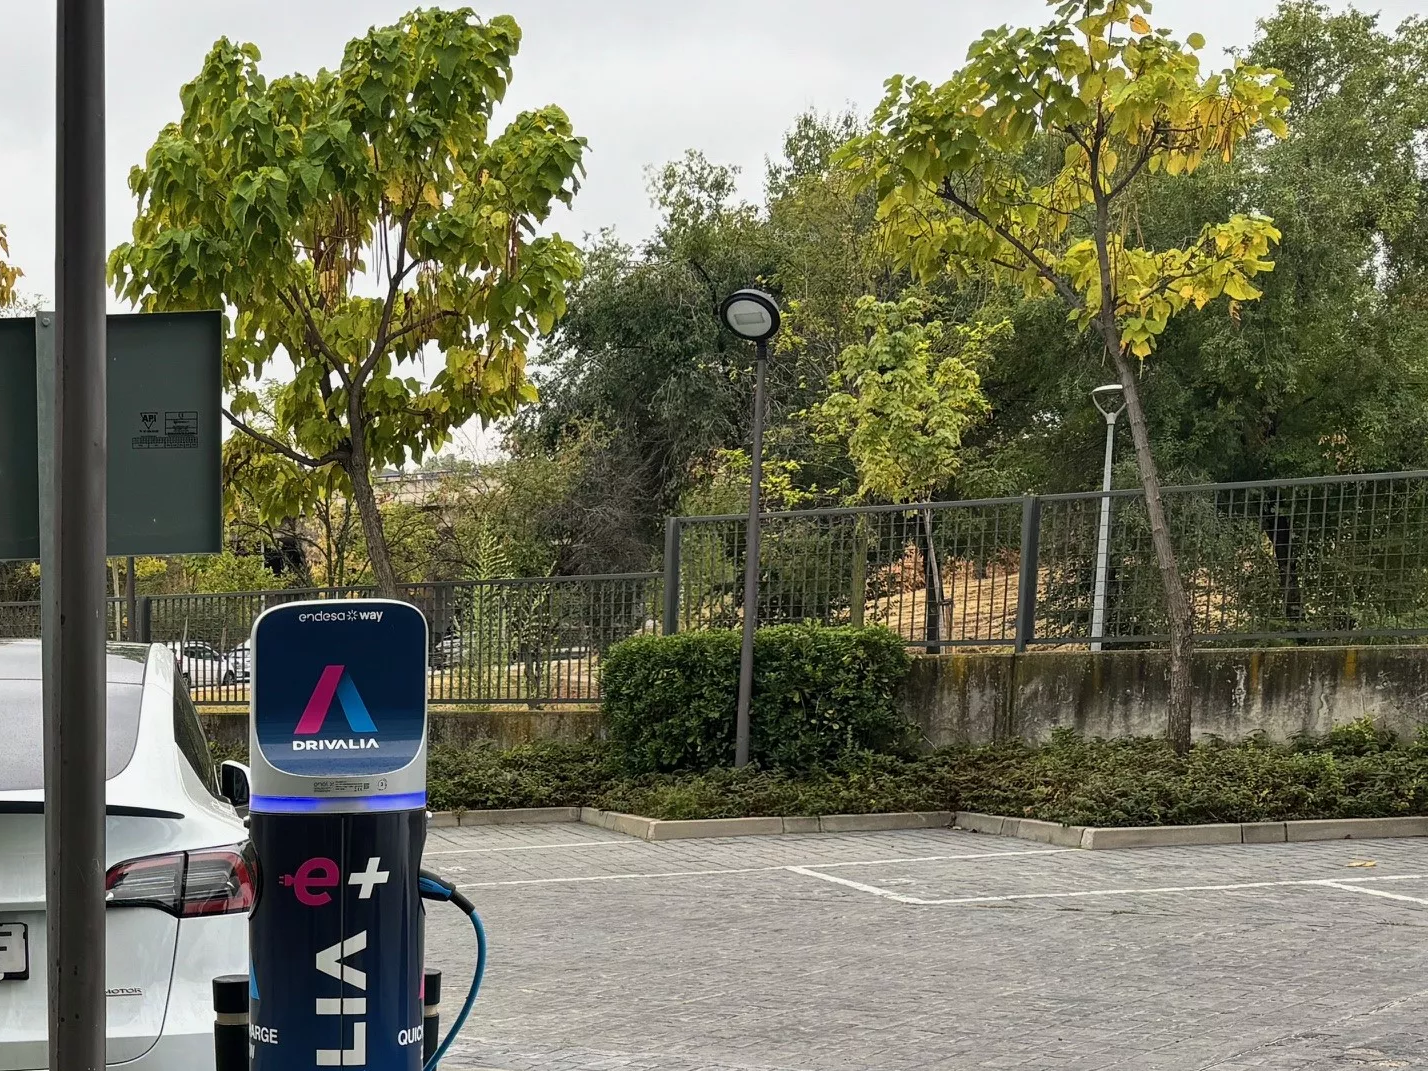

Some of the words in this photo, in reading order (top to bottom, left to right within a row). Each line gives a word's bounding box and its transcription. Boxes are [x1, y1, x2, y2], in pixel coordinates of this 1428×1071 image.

[298, 610, 346, 623] endesa
[359, 610, 384, 623] way
[292, 738, 380, 751] DRIVALIA
[249, 1024, 279, 1045] ARGE
[398, 1025, 424, 1046] QUIC
